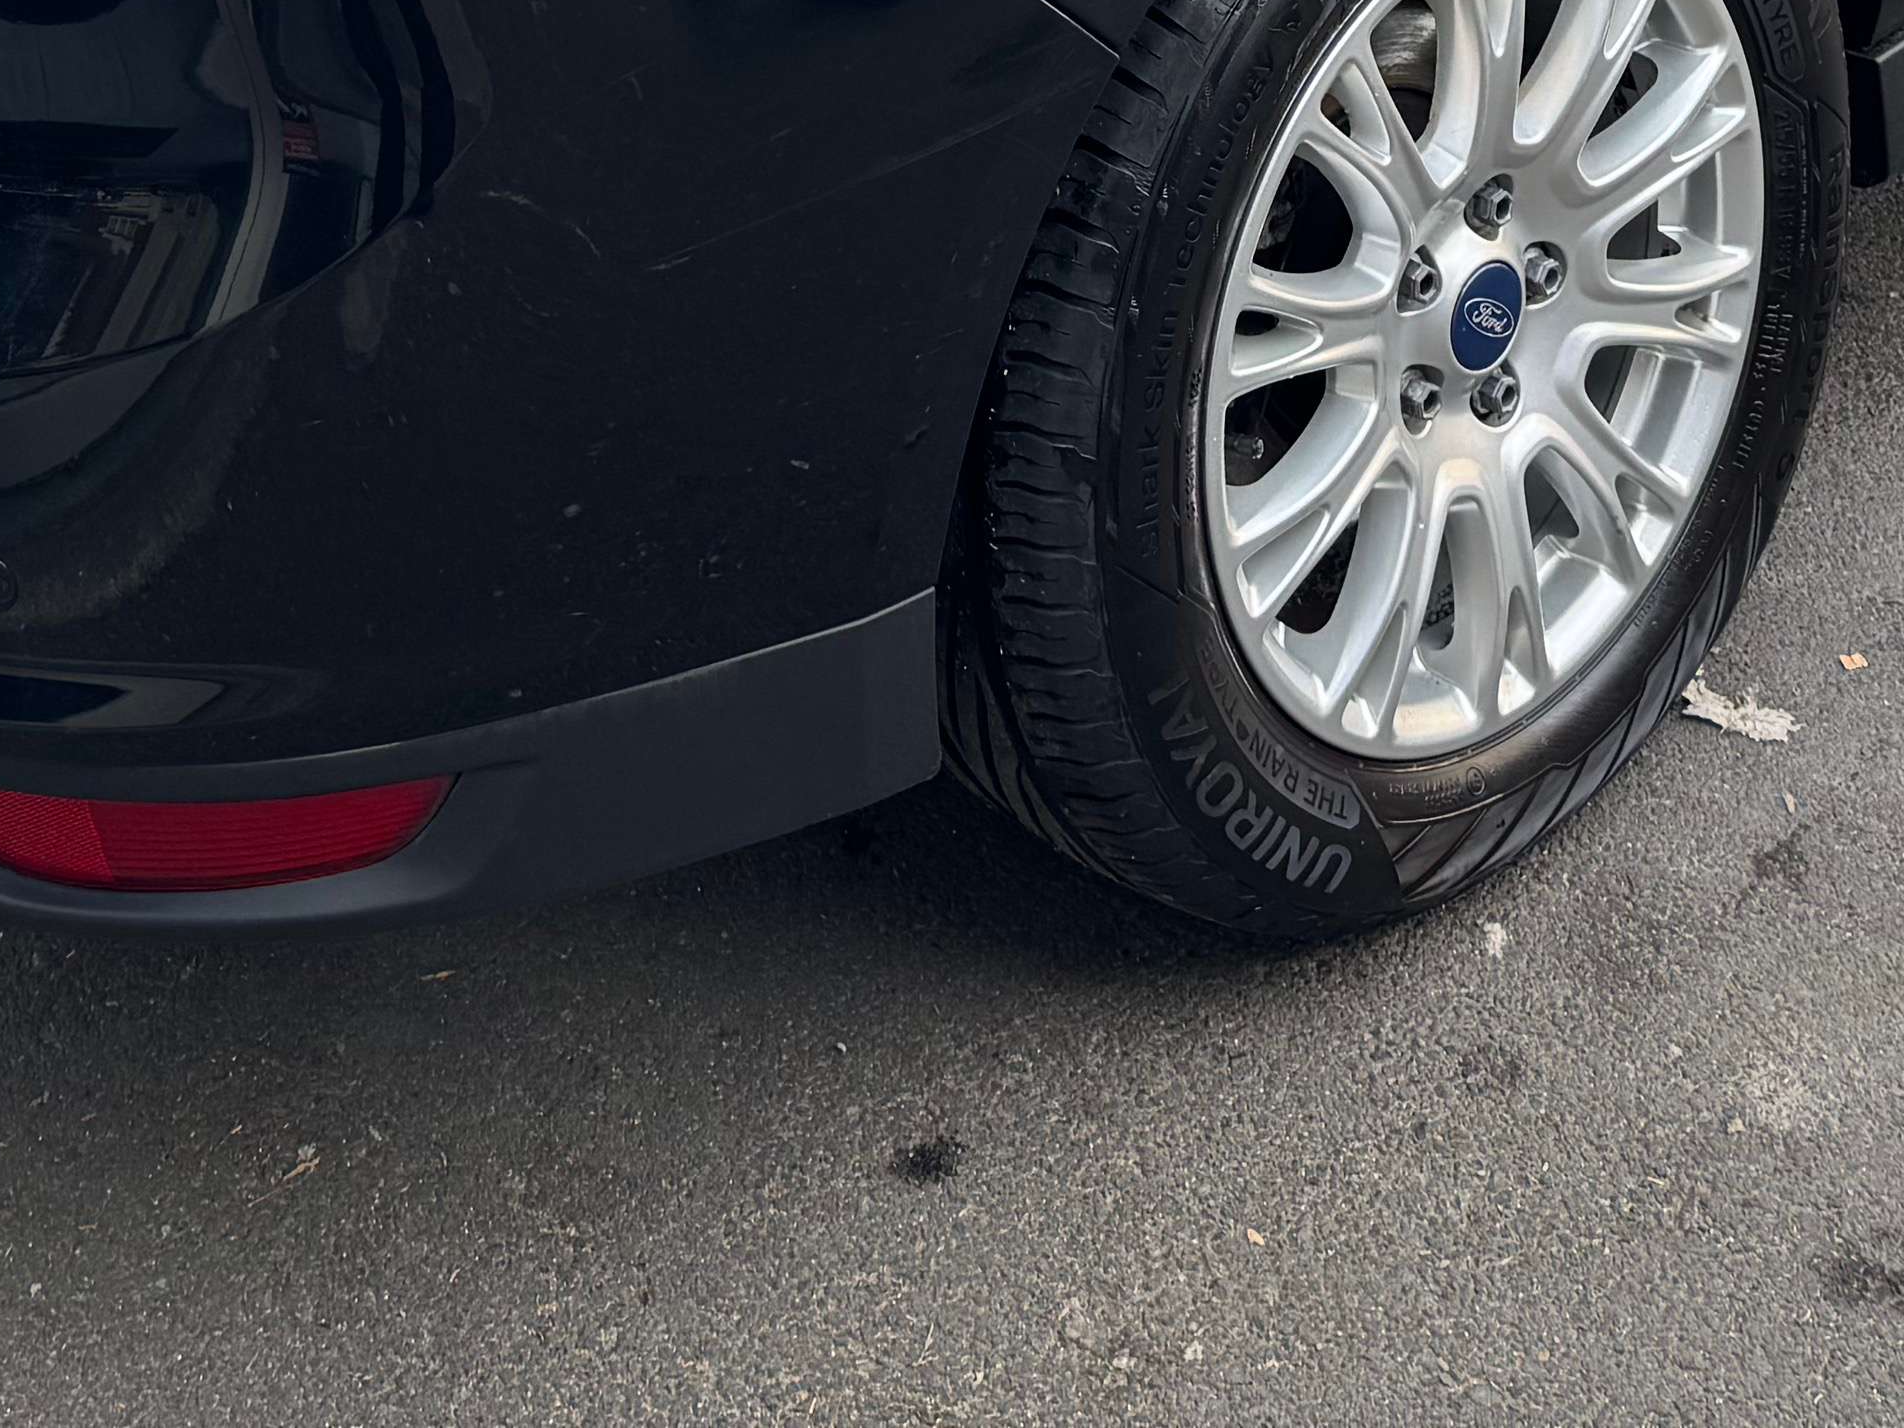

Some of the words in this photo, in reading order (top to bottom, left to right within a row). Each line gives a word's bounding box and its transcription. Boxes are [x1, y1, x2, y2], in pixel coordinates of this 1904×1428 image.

[1471, 301, 1508, 334] Ford
[1249, 732, 1301, 796] RAIN
[1304, 782, 1349, 821] THE
